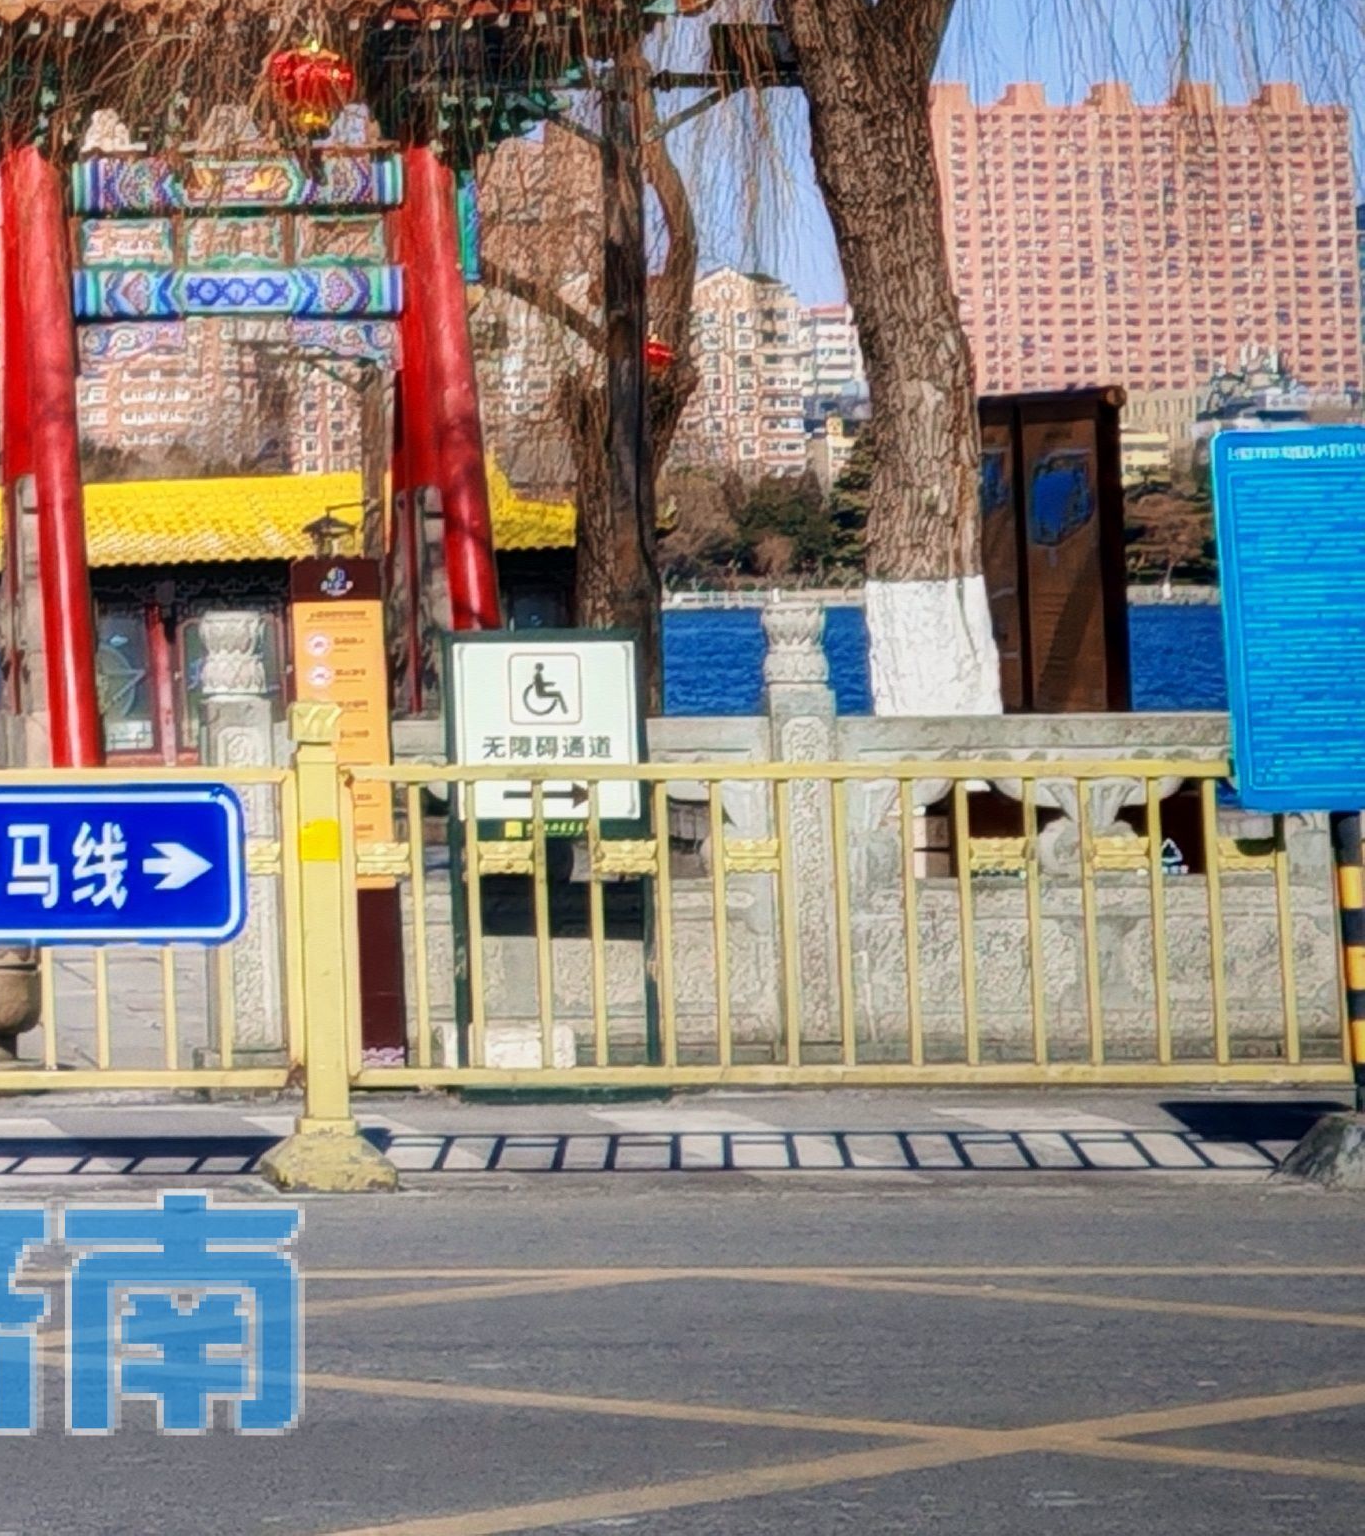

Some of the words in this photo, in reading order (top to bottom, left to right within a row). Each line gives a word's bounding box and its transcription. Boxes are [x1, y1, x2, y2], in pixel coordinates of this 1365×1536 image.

[482, 736, 612, 759] 无障碍通道
